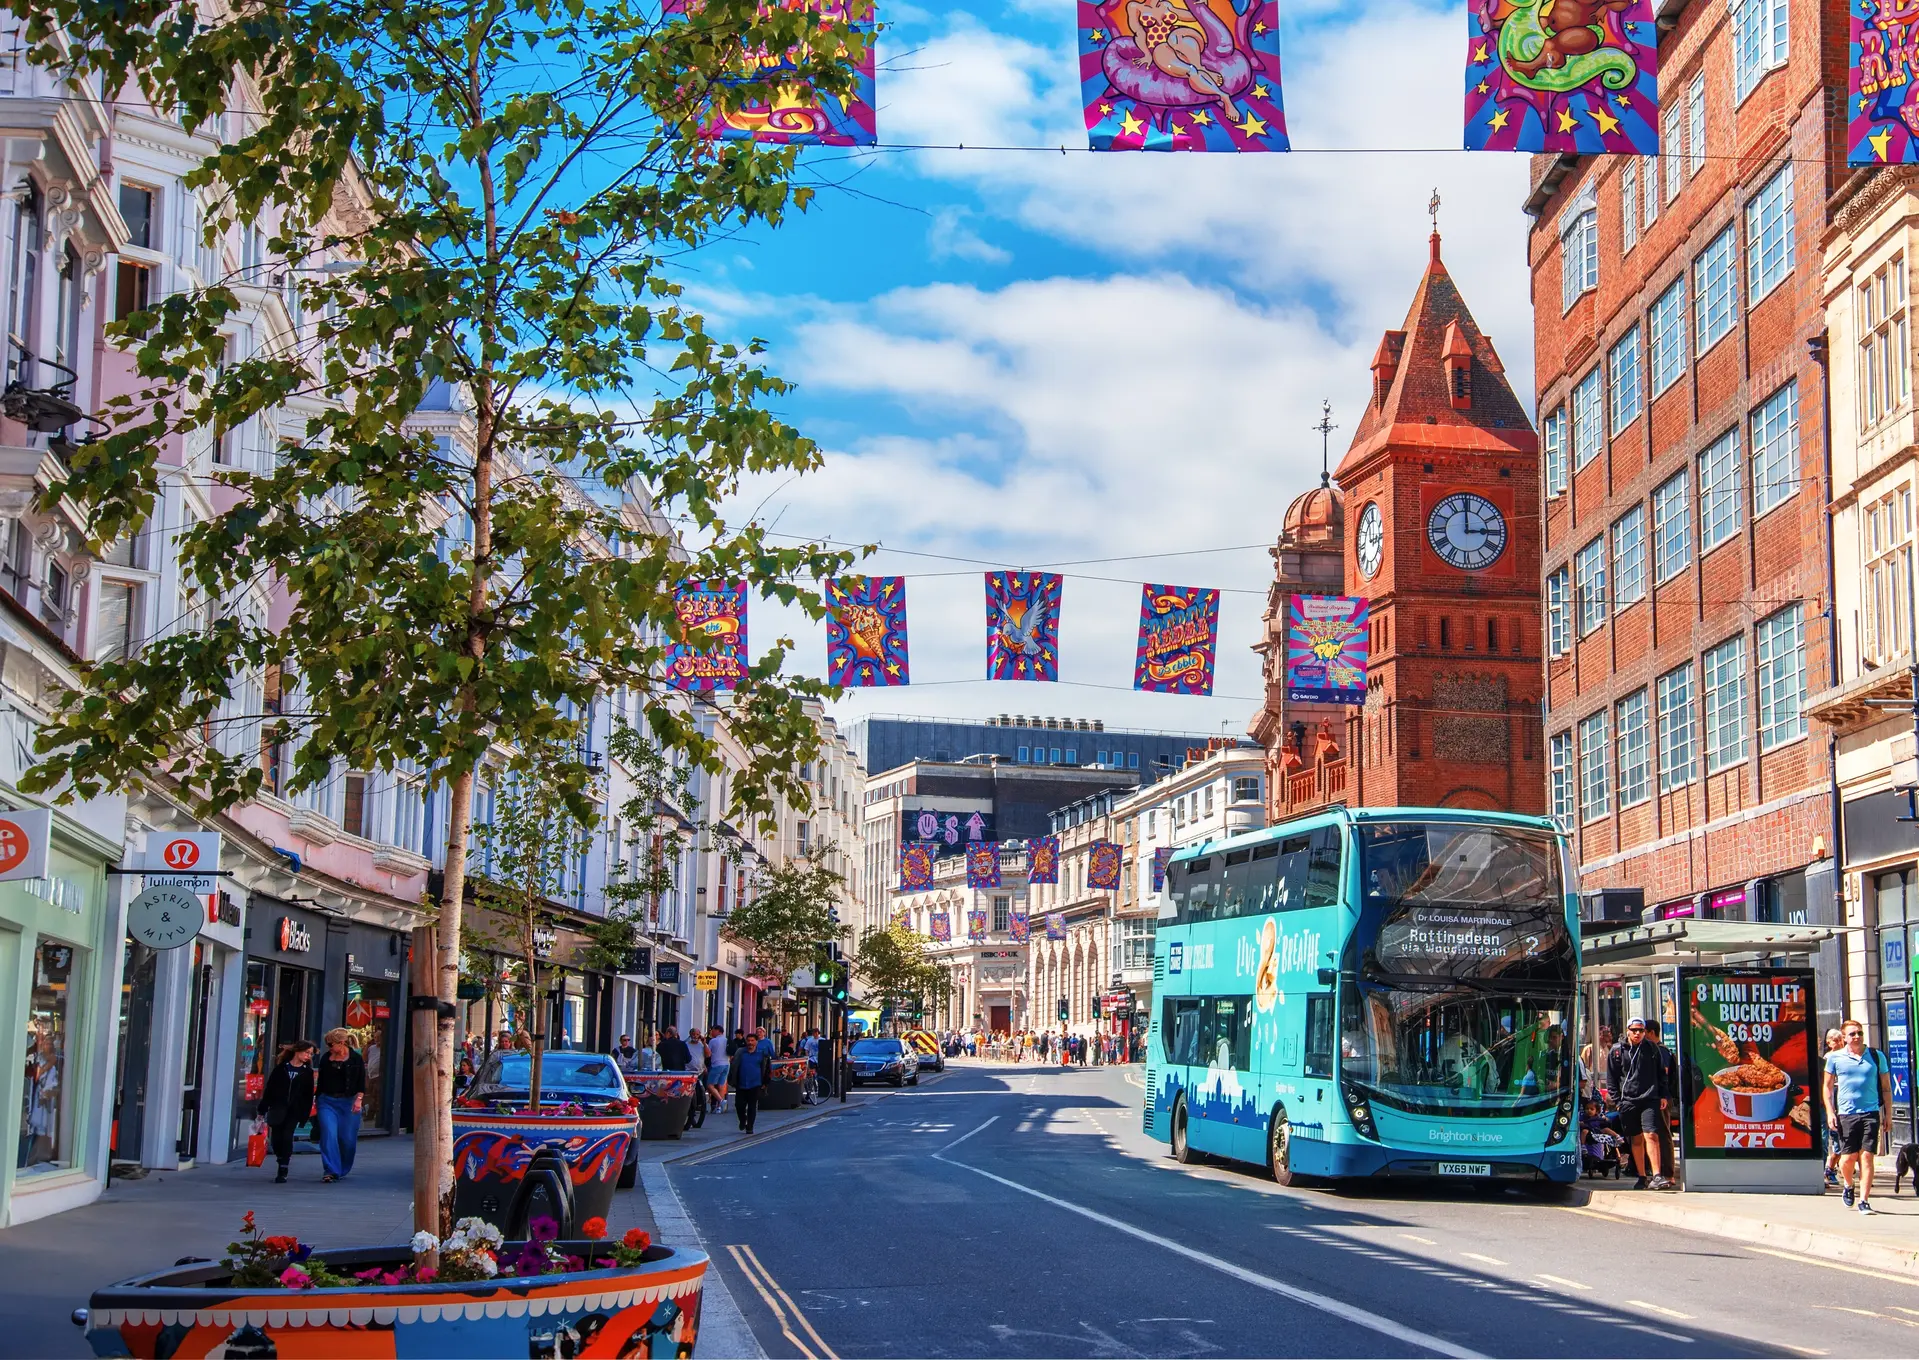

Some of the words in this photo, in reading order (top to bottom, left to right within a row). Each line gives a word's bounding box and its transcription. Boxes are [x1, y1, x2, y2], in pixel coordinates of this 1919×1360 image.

[1314, 641, 1345, 660] POP!
[149, 876, 210, 888] lululemon
[144, 893, 190, 910] ASTRID
[160, 911, 171, 923] &
[1429, 915, 1459, 923] LOUISA
[1460, 917, 1512, 926] MARTINDALE
[144, 926, 186, 941] MIYU
[288, 920, 311, 952] Blacks
[1409, 929, 1500, 946] Rottingdean
[1236, 935, 1257, 977] LIVE
[1281, 928, 1321, 975] BREATHE
[1402, 944, 1420, 952] via
[1425, 943, 1507, 957] Woodingdean
[1525, 936, 1539, 956] 2
[1885, 940, 1902, 962] 170
[1696, 984, 1708, 1002] 8
[1712, 983, 1747, 1002] MINI
[1752, 984, 1800, 1003] FILLET
[1719, 1003, 1779, 1022] BUCKET
[1727, 1023, 1772, 1042] £6.99
[1722, 1106, 1734, 1115] KFC
[1724, 1132, 1785, 1148] KFC
[1560, 1154, 1575, 1165] 318
[1442, 1164, 1467, 1174] YX69
[1468, 1165, 1486, 1174] NWF
